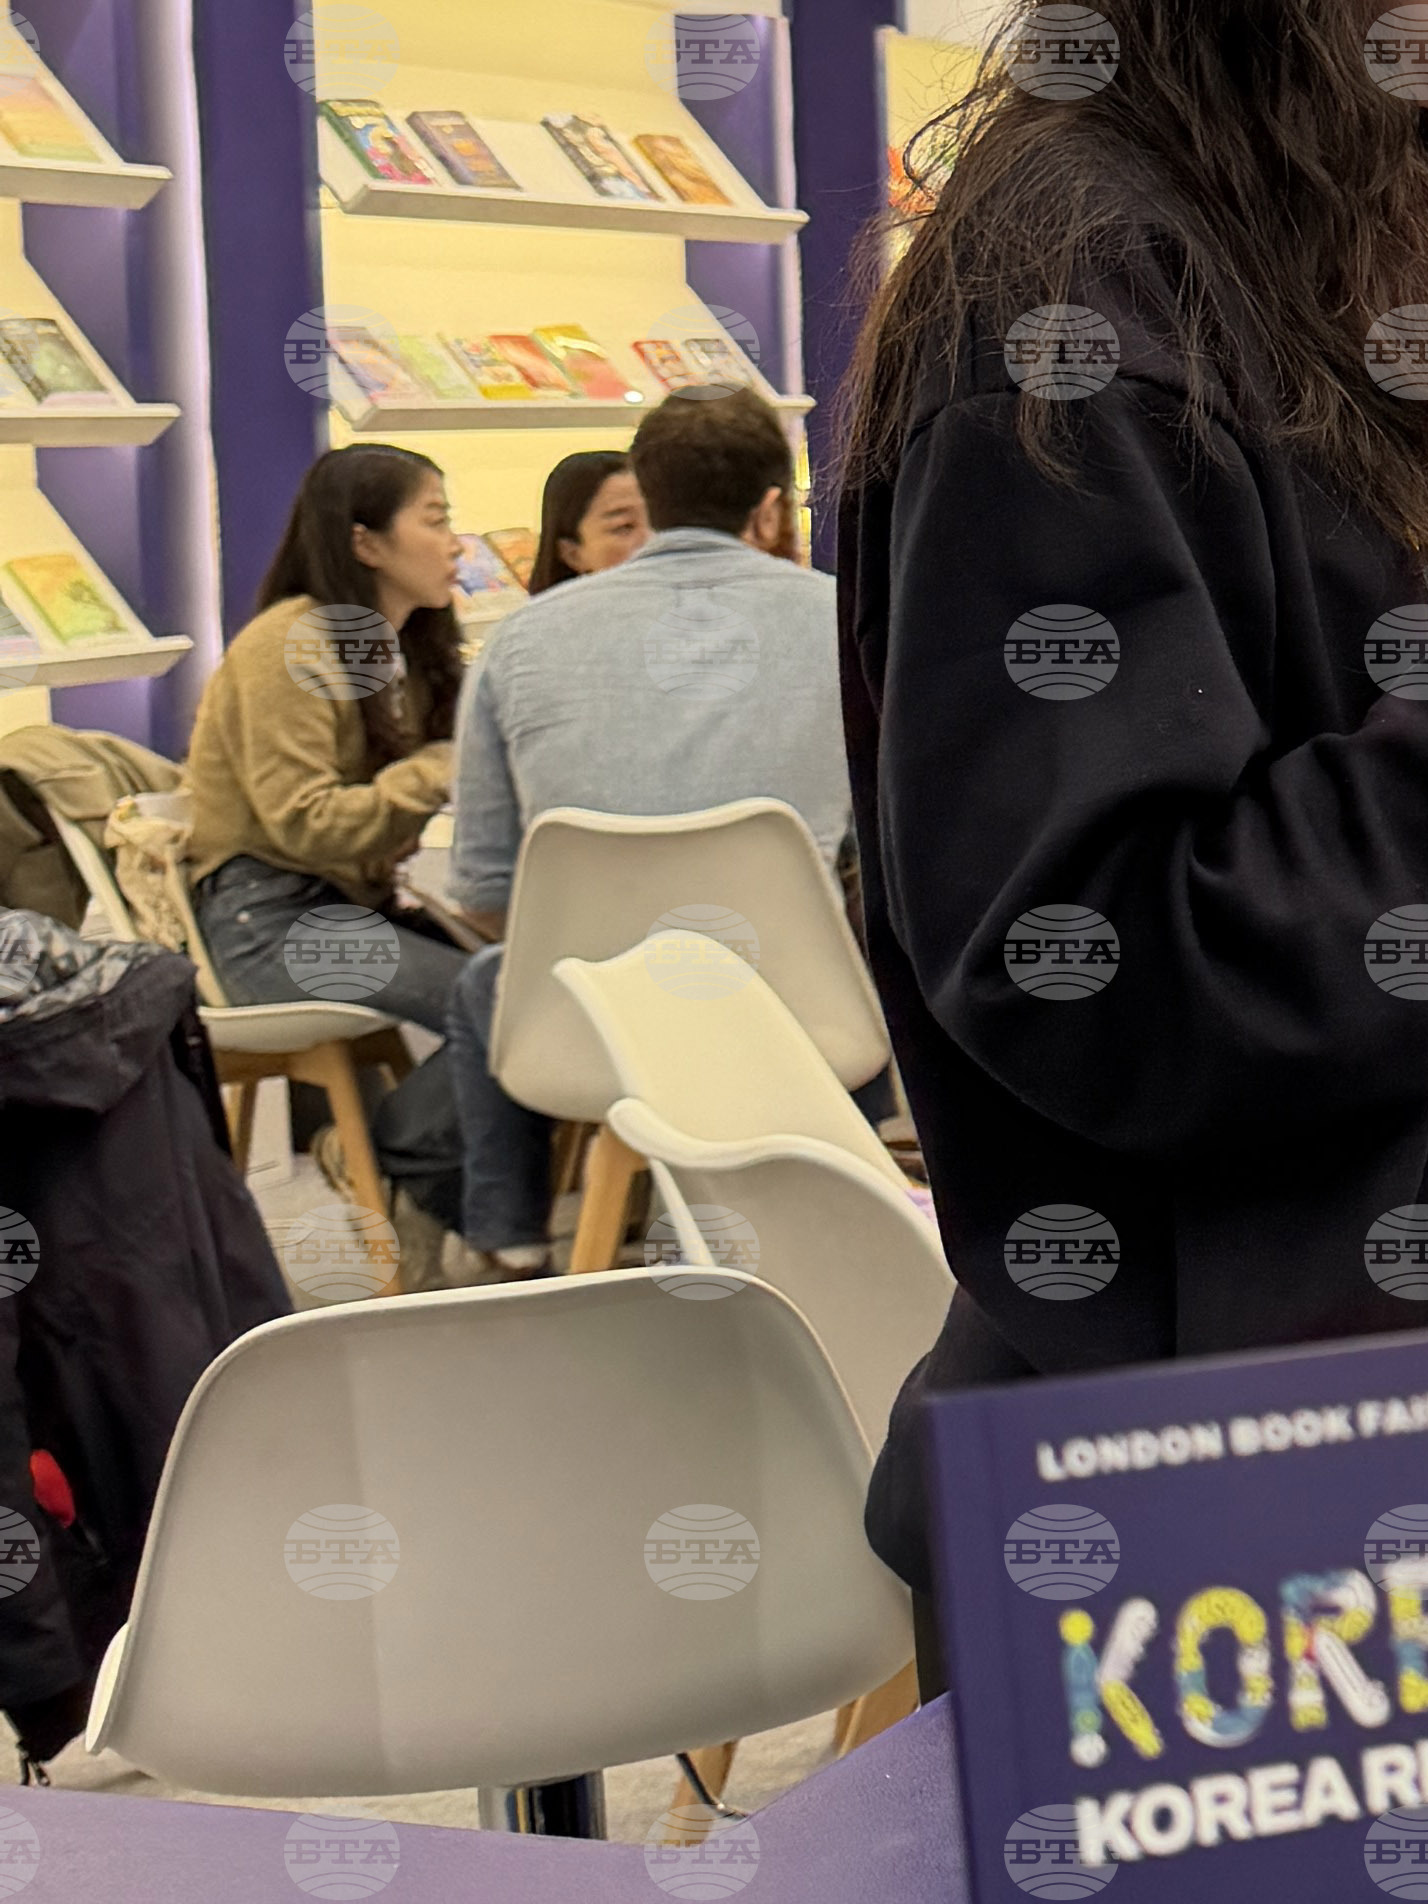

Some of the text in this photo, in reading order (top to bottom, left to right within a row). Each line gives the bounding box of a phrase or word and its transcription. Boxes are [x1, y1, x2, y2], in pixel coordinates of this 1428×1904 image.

[1037, 1422, 1223, 1483] LONDON
[1229, 1405, 1355, 1458] BOOK
[1075, 1753, 1360, 1868] KOREA
